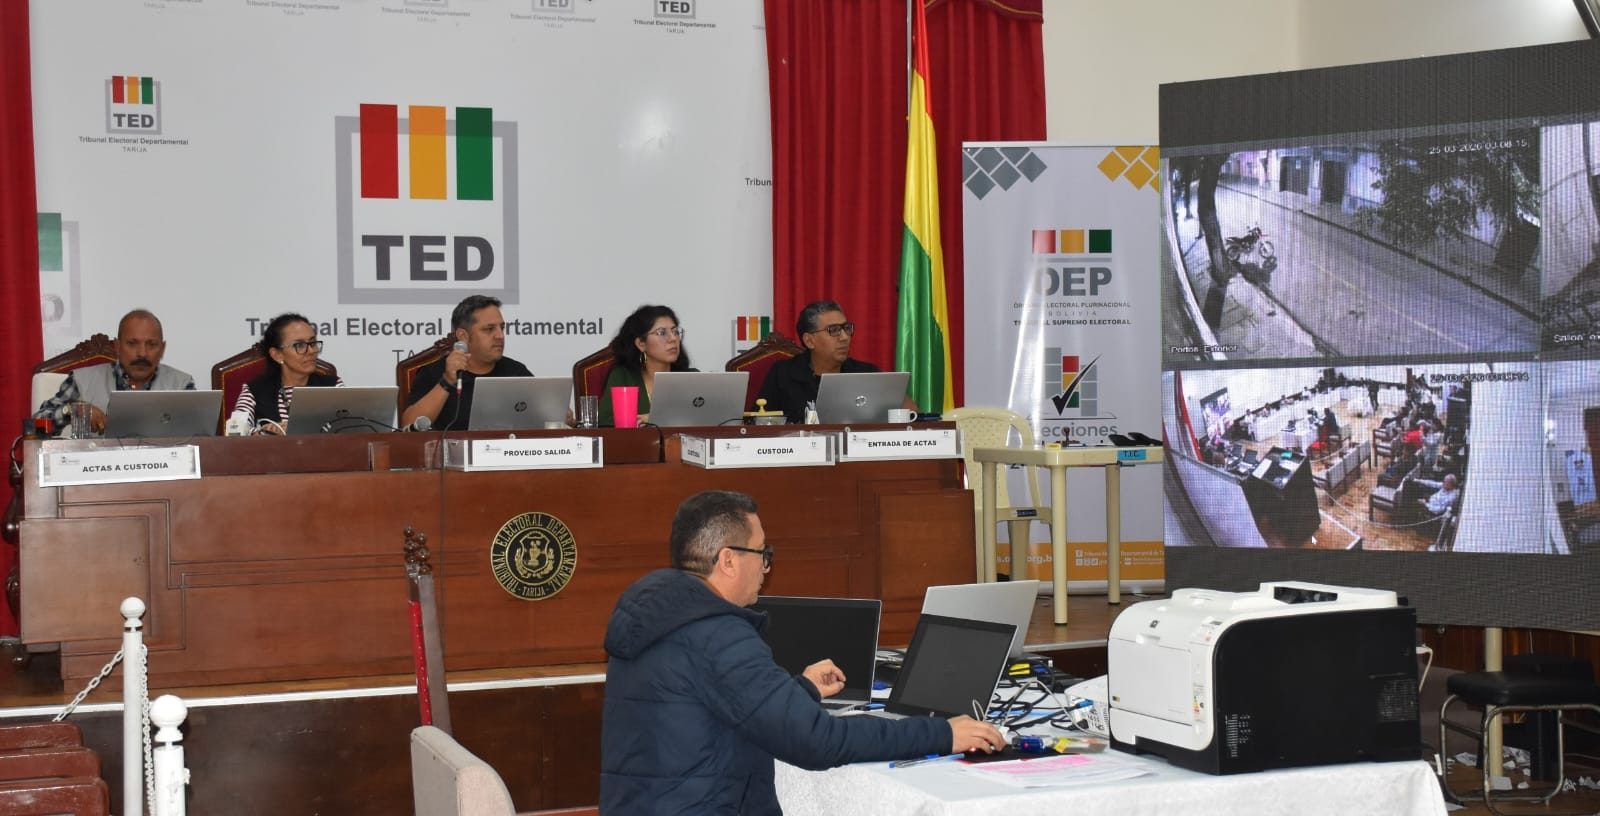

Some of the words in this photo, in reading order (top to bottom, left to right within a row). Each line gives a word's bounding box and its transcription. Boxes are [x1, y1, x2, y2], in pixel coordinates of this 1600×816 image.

[659, 1, 690, 13] TED
[113, 113, 154, 128] TED
[79, 136, 106, 144] Tribunal
[108, 137, 138, 145] Electoral
[140, 138, 189, 146] Departamental
[744, 177, 772, 187] Tribun
[361, 235, 494, 281] TED
[1035, 267, 1112, 296] OEP
[346, 317, 443, 337] Electoral
[505, 318, 604, 337] rtamental
[868, 440, 901, 448] ENTRADA
[913, 439, 937, 447] ACTAS
[503, 449, 543, 457] PROVEIDO
[544, 448, 571, 456] SALIDA
[757, 447, 794, 455] CUSTODIA
[124, 463, 168, 471] CUSTODIA
[495, 513, 543, 548] ELECTORAL
[546, 518, 577, 593] DEPARTAMENTAL
[492, 551, 520, 593] TRIBUNAL
[522, 586, 546, 597] TARIJA
